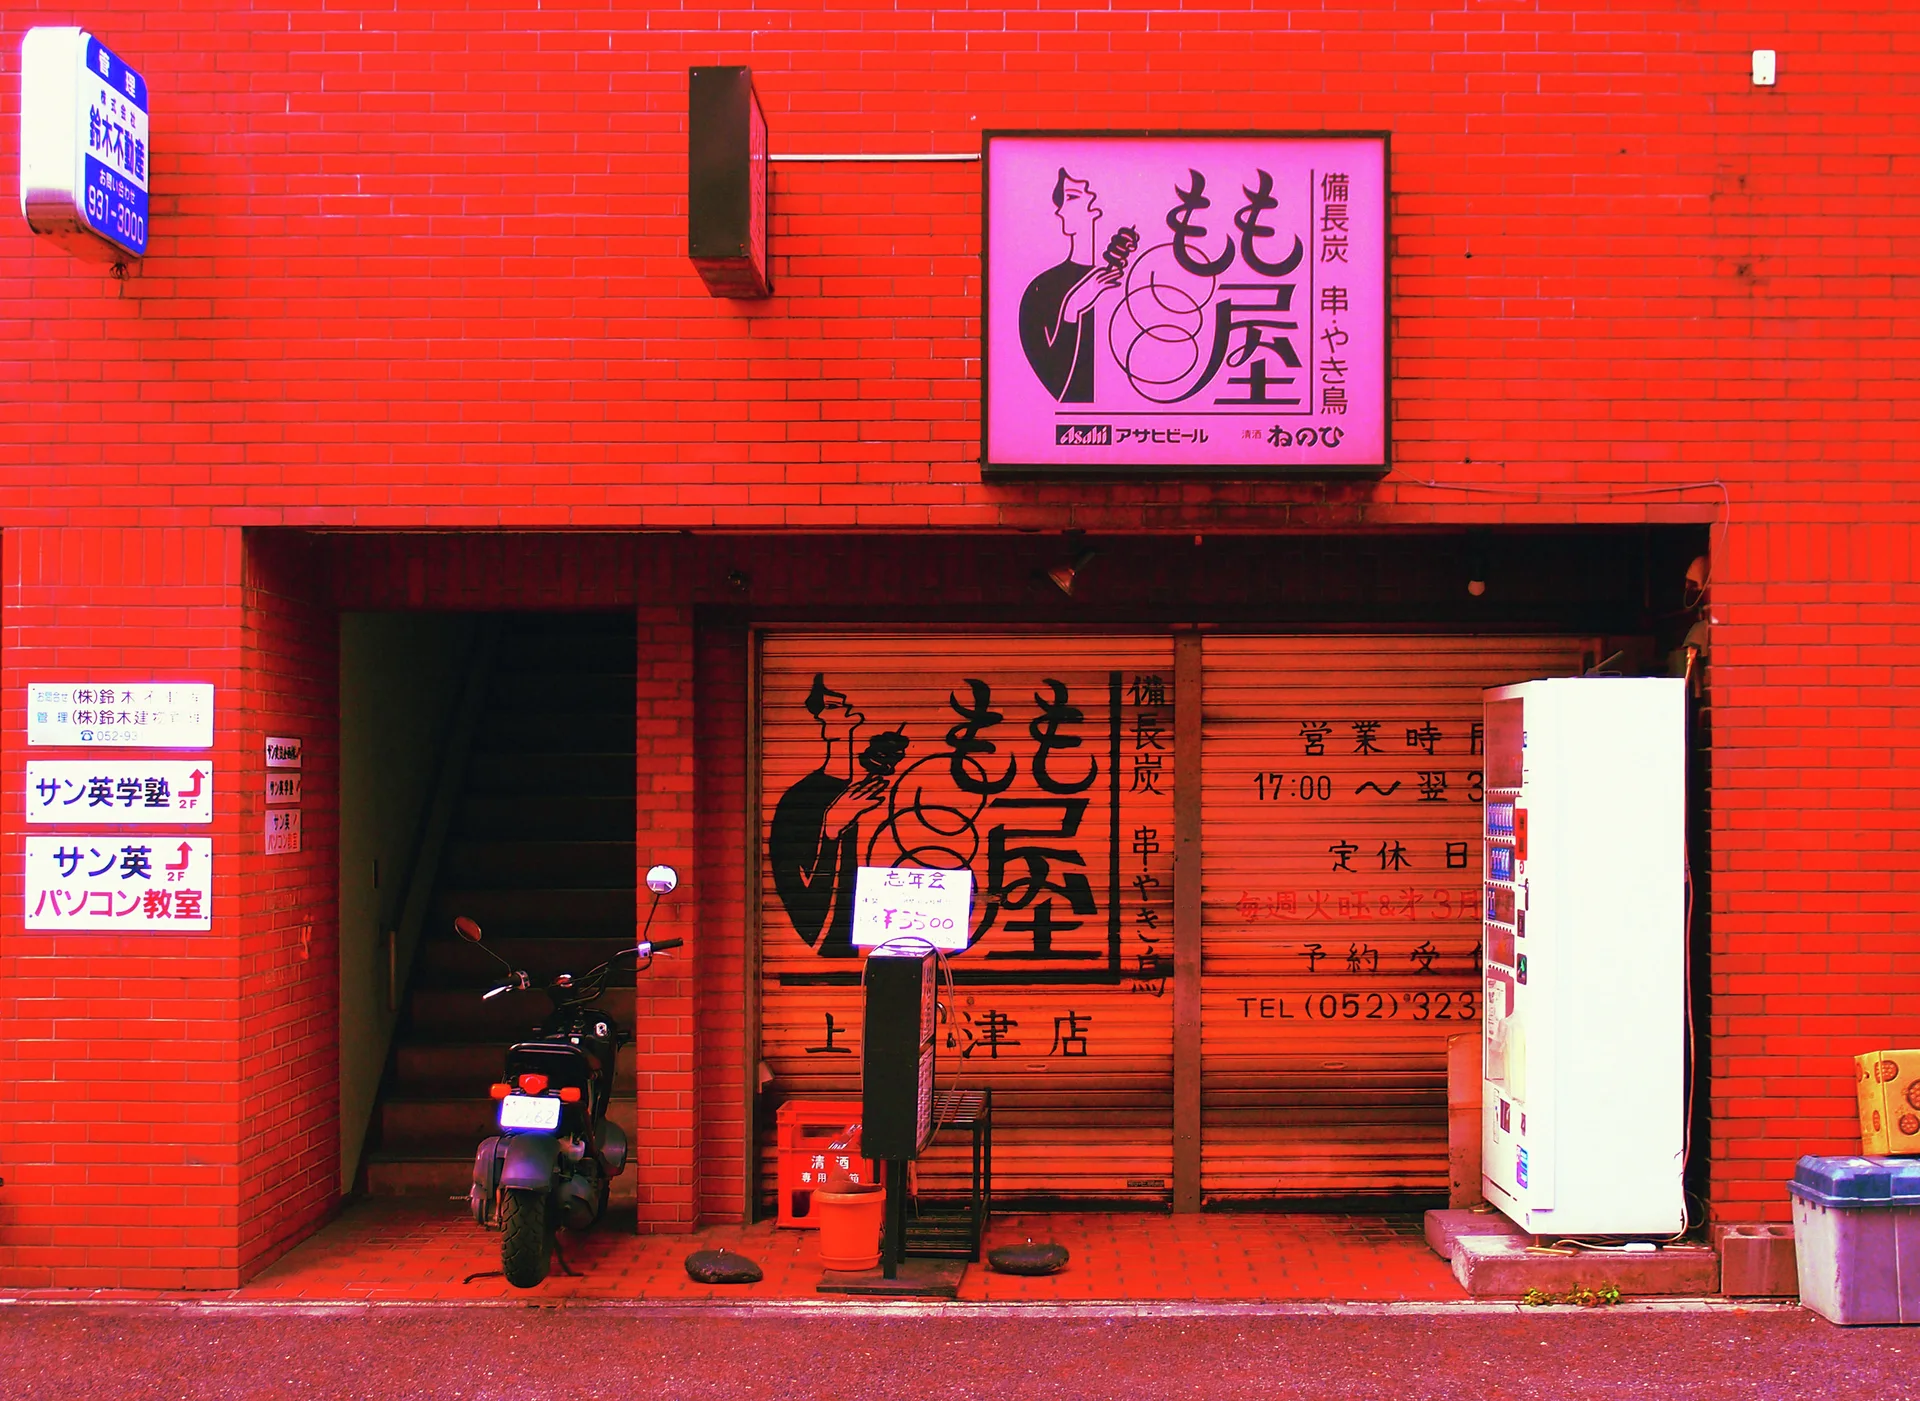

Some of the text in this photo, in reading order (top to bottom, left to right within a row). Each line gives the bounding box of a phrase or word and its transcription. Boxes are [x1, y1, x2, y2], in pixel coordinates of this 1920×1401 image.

[100, 89, 136, 129] 株式会社
[89, 103, 146, 183] 鈴木不動産
[99, 168, 136, 205] お問い合わせ
[87, 184, 144, 245] 931-3000
[1165, 167, 1304, 277] もも
[1319, 172, 1350, 264] 備長炭
[1178, 283, 1304, 406] 屋
[1058, 424, 1345, 448] Asahi アサヒビール 清酒 ねのひ
[945, 678, 1098, 795] もも
[1127, 674, 1166, 796] 備長炭
[35, 776, 198, 809] サン英学塾 2F
[53, 845, 185, 882] サン英 2F
[1328, 840, 1469, 873] 定休日
[883, 870, 946, 890] 忘年会
[984, 798, 1103, 960] 屋
[35, 888, 203, 919] パソコン教室
[1236, 997, 1295, 1019] TEL
[804, 1010, 1093, 1059] 上津店
[811, 1155, 849, 1169] 清酒
